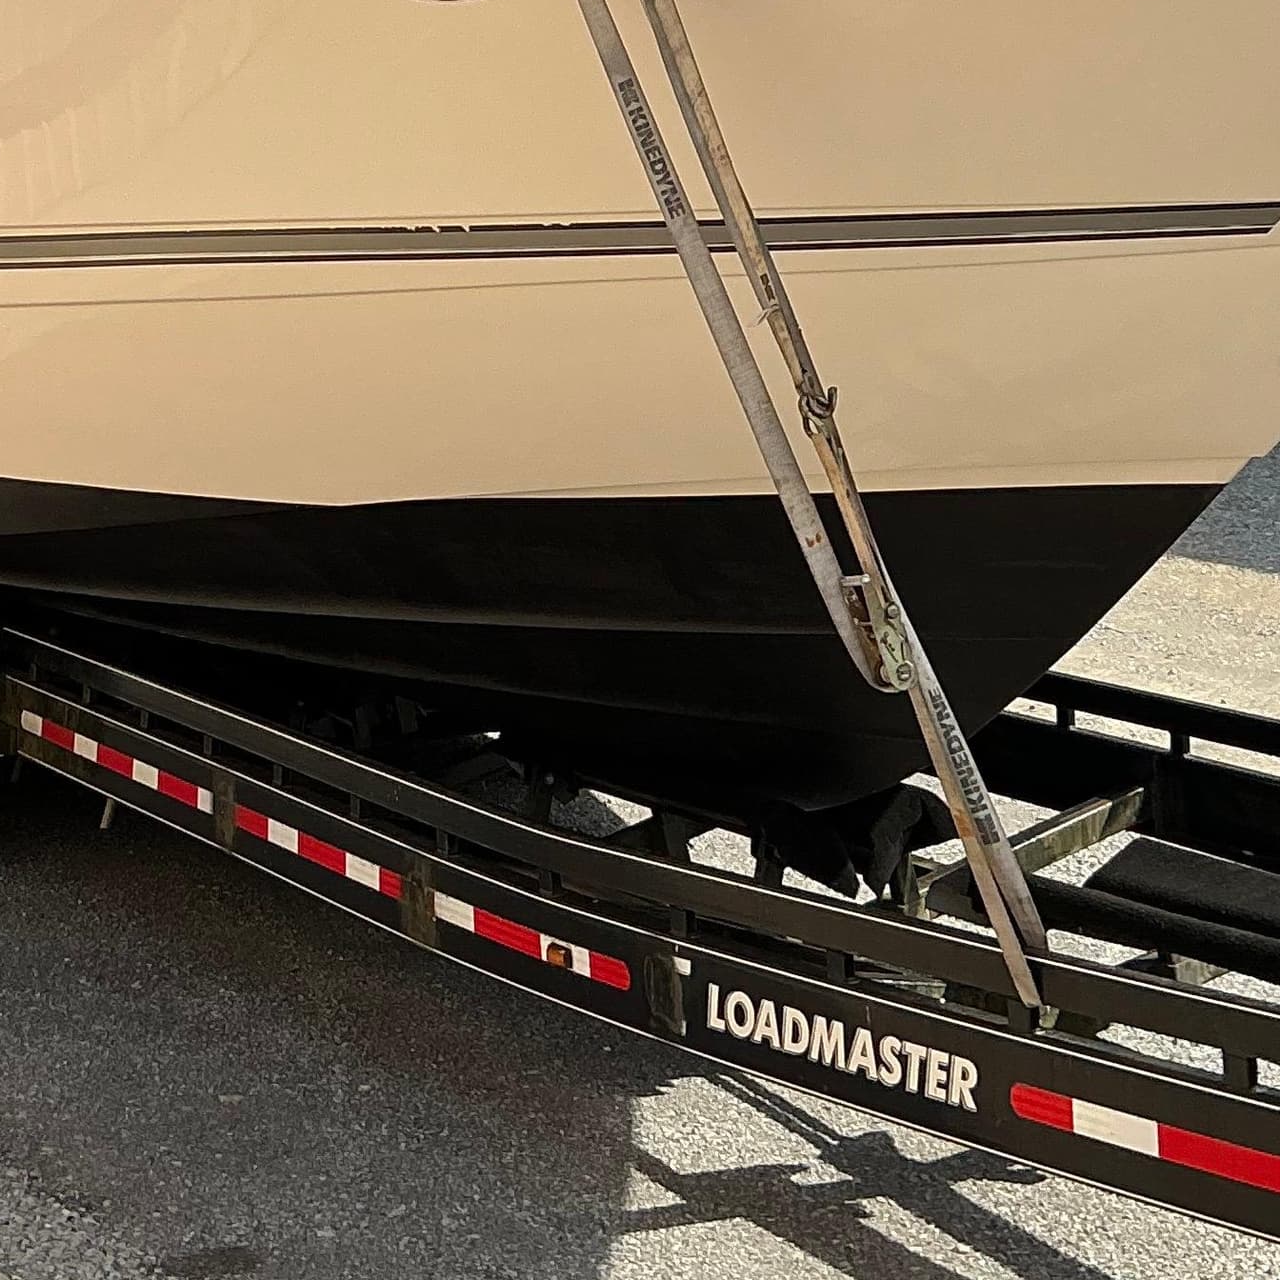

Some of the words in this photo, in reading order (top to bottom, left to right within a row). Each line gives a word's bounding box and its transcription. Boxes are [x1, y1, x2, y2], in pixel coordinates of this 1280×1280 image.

[628, 106, 686, 220] KINEDYNE
[927, 688, 989, 815] KINEDYNE
[706, 982, 978, 1112] LOADMASTER
